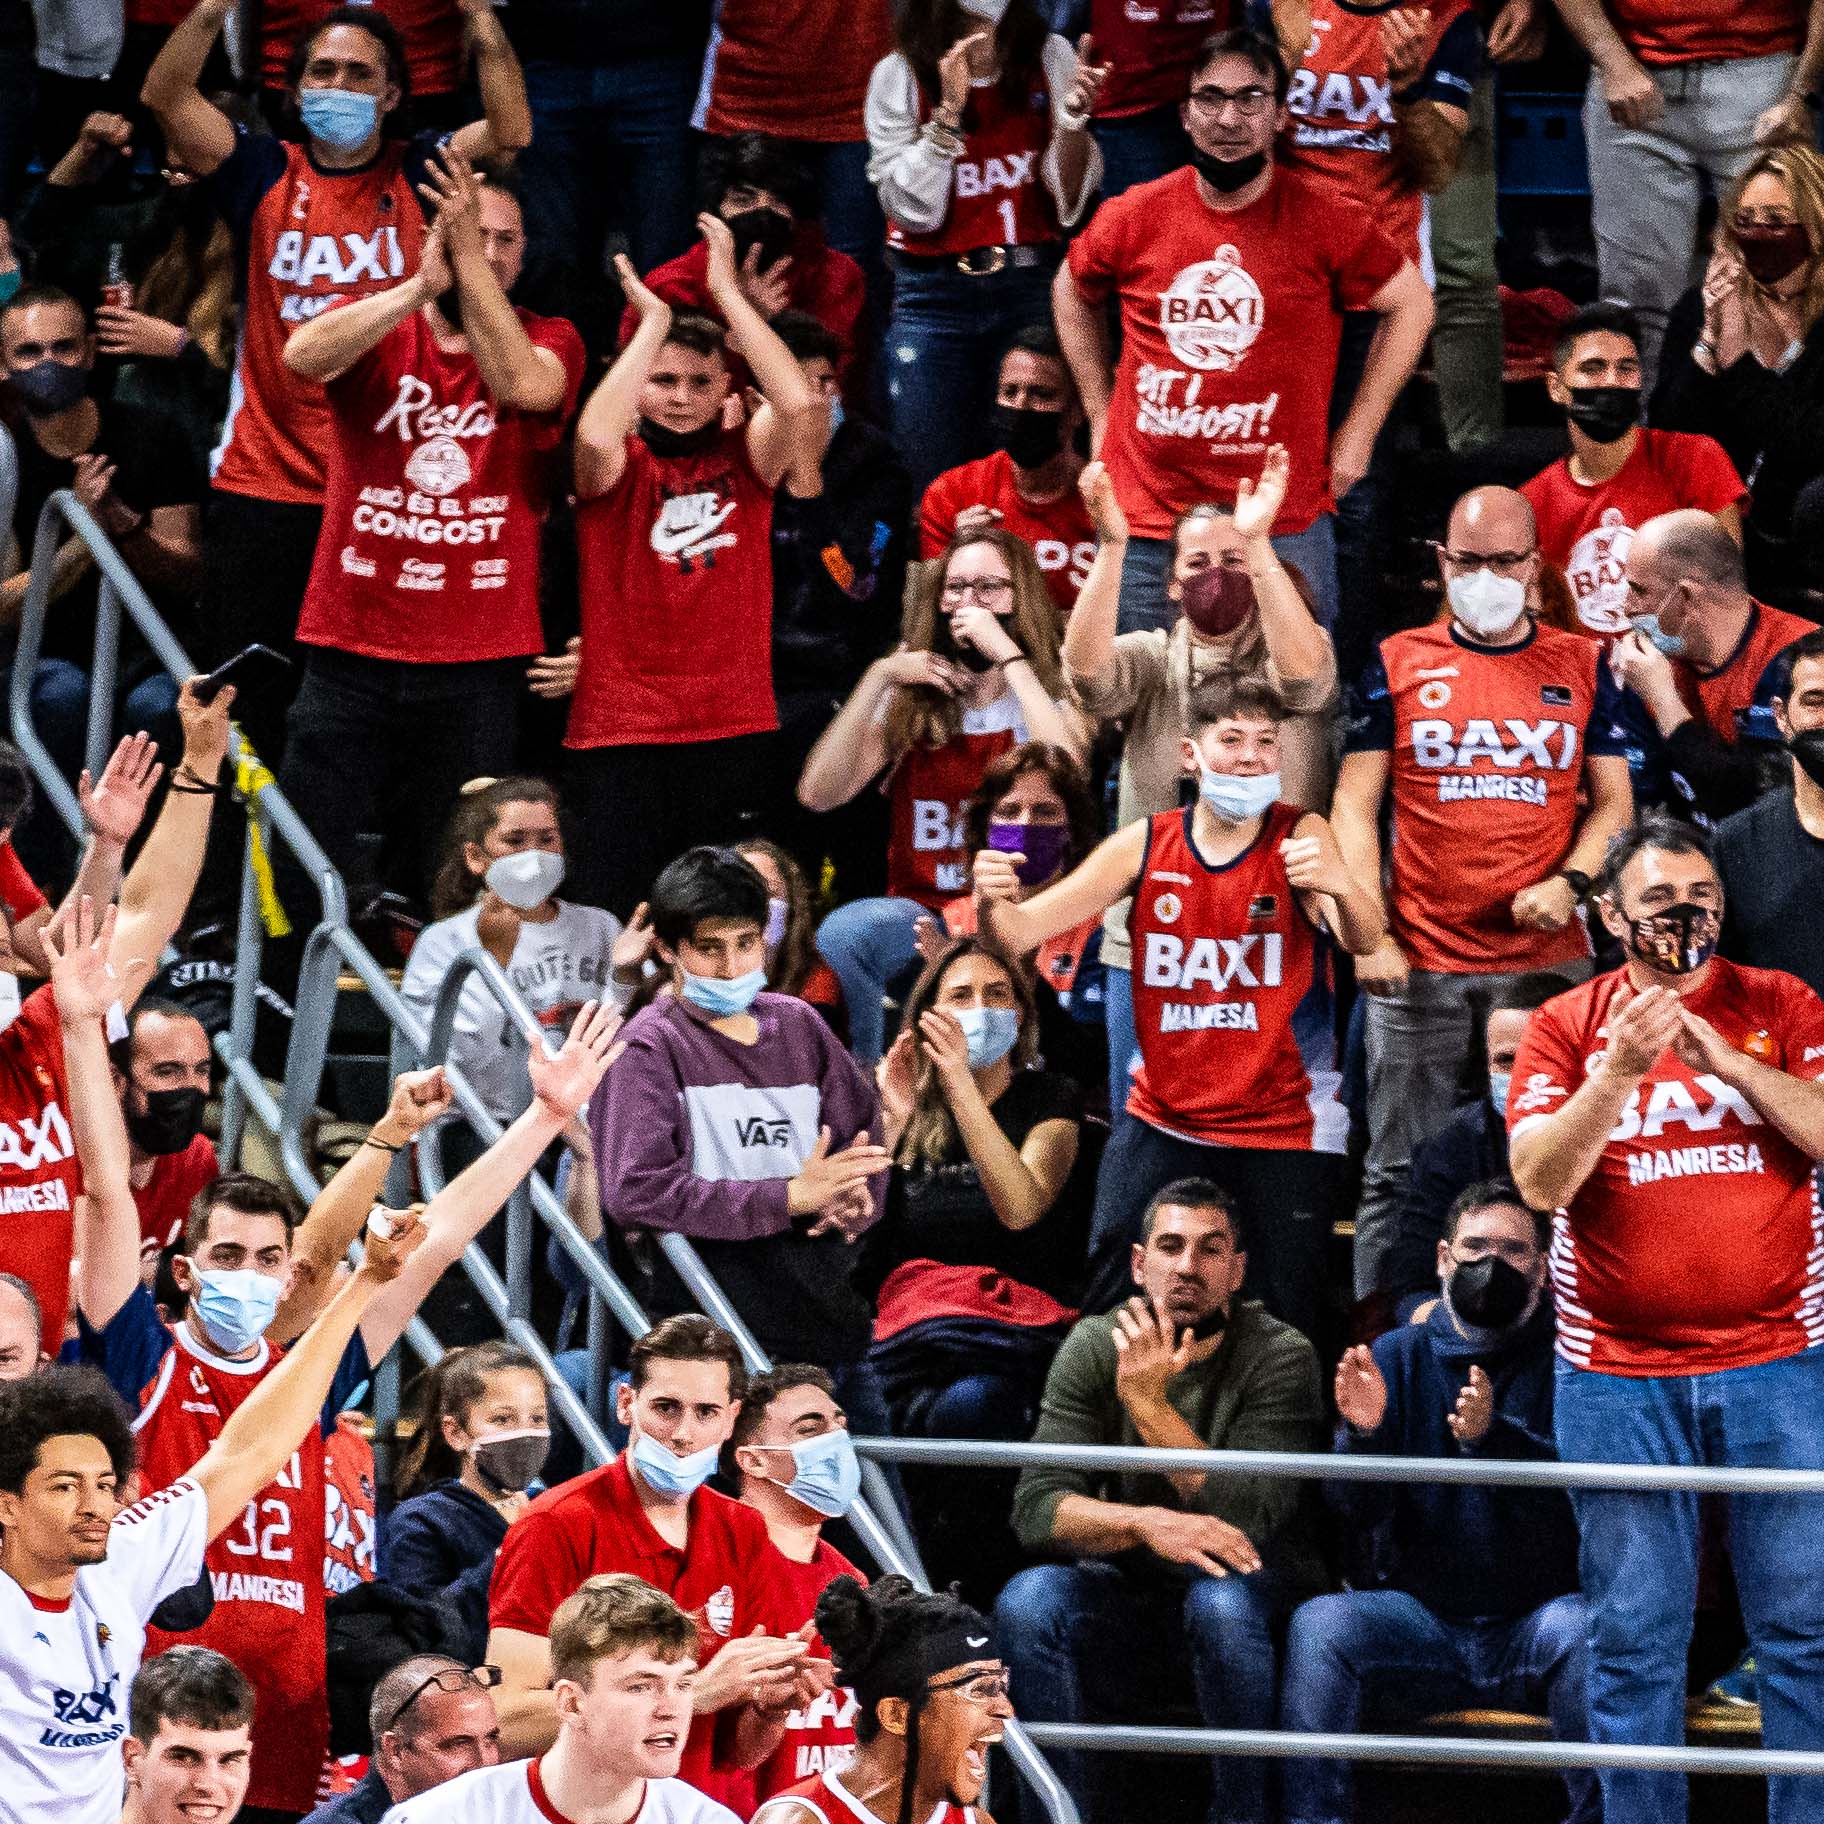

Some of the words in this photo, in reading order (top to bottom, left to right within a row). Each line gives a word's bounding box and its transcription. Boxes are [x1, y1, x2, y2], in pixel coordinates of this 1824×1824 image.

[1287, 70, 1398, 122] BAX
[954, 152, 1031, 199] BAX
[268, 226, 404, 286] BAXI
[1164, 297, 1257, 326] BAXI
[353, 506, 509, 544] CONGOST
[1410, 719, 1577, 771] BAXI
[1143, 933, 1283, 992] BAXI
[1646, 1143, 1765, 1187] MANRESA
[224, 1499, 294, 1563] 32
